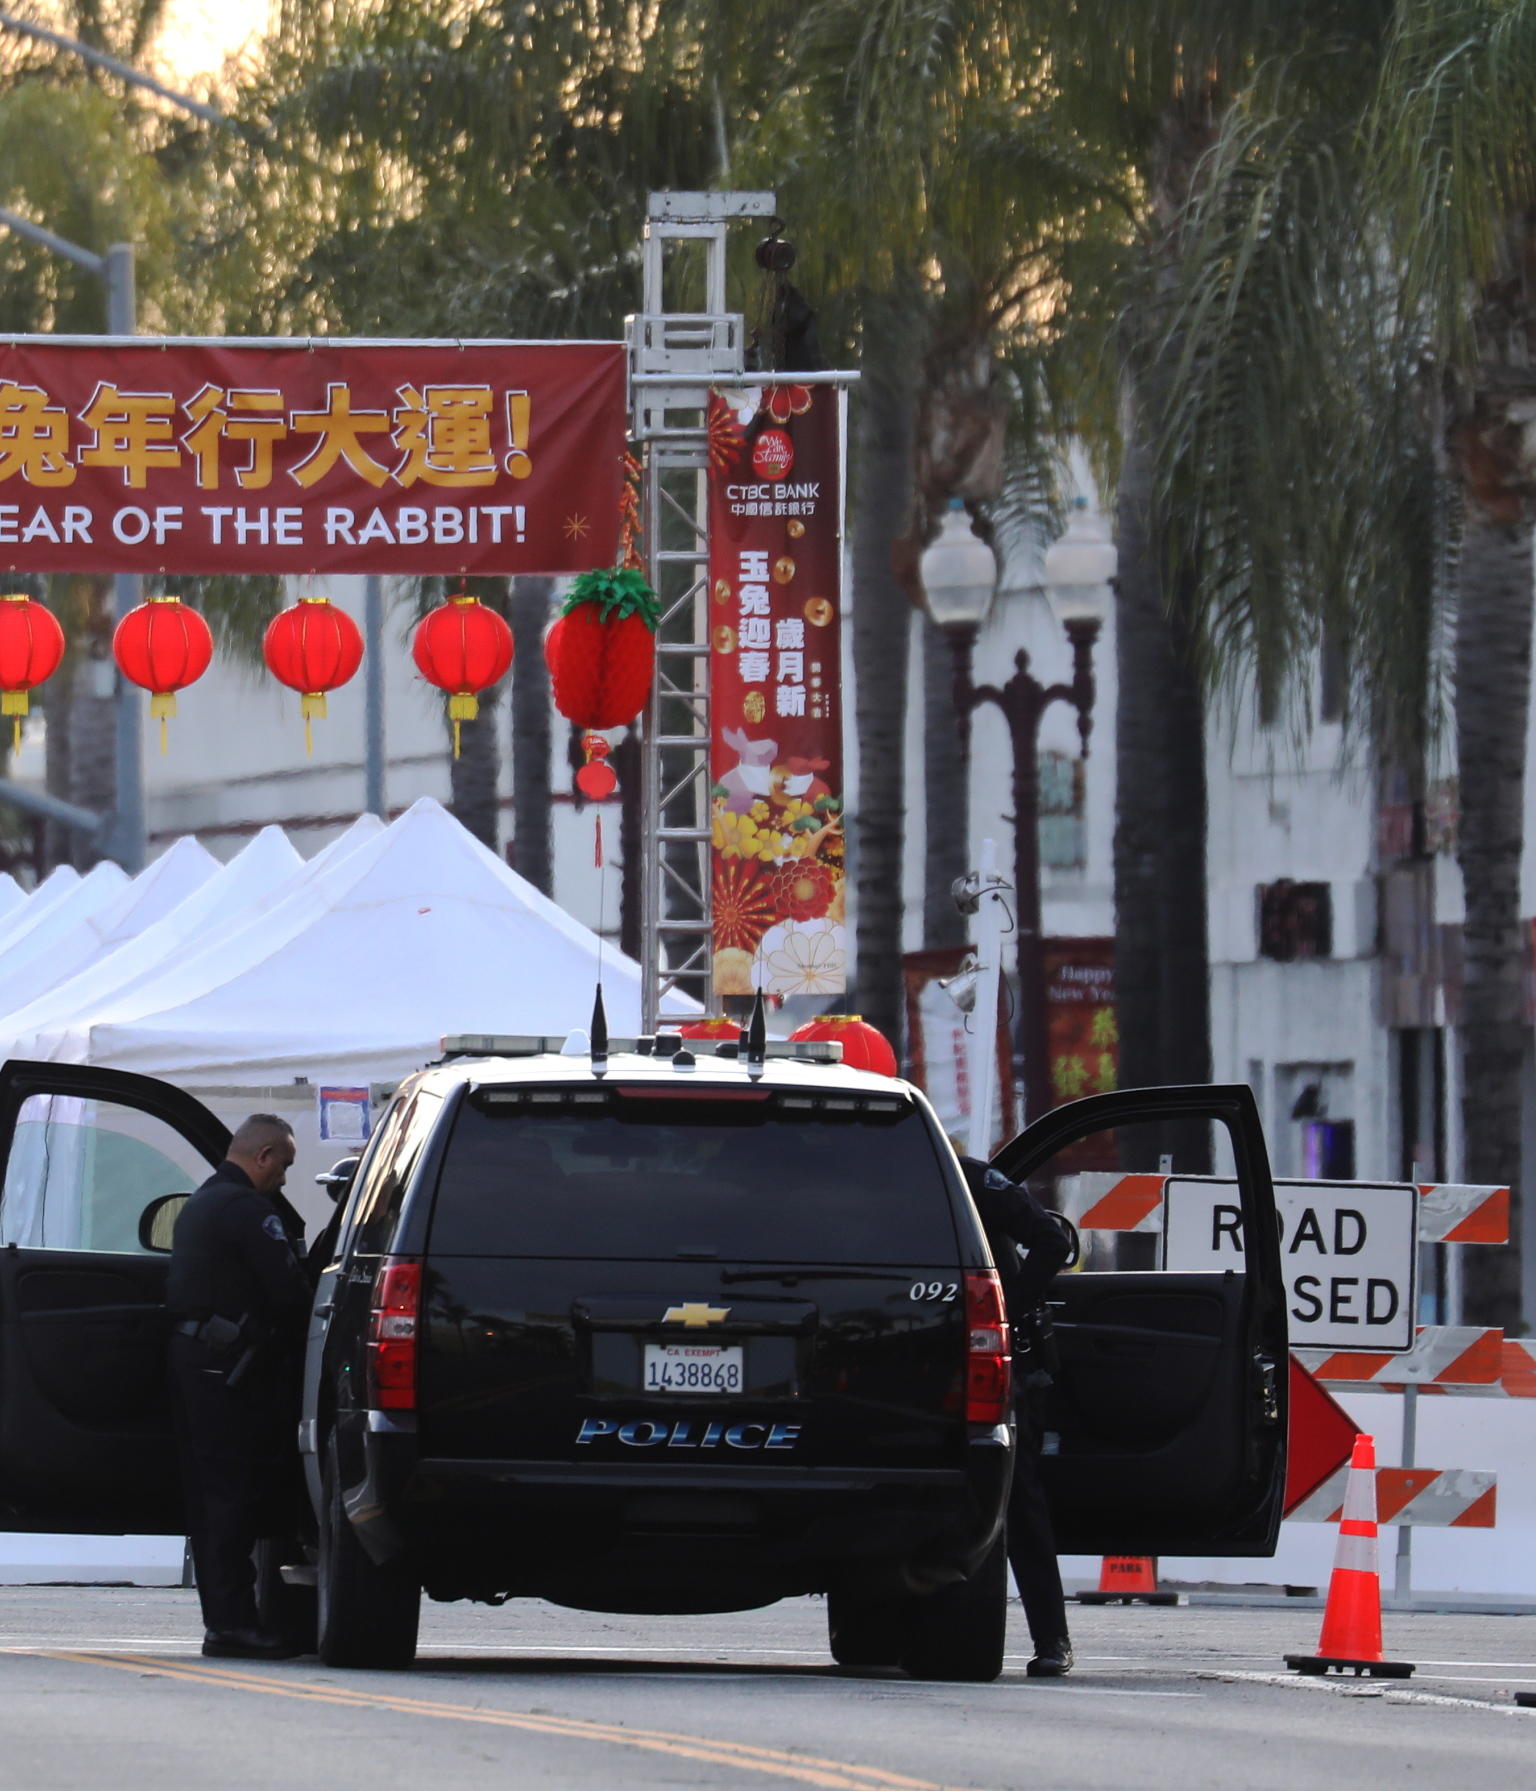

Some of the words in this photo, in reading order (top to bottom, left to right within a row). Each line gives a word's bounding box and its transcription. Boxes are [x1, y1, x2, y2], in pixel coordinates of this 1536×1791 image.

[727, 484, 770, 500] CTBC
[775, 482, 821, 499] BANK
[112, 505, 184, 546] OF
[201, 506, 303, 545] THE
[326, 506, 528, 546] RABBIT!
[738, 550, 771, 683] 玉兔迎春
[776, 618, 806, 718] 歲月新
[1061, 965, 1113, 984] Happy
[1212, 1204, 1367, 1256] RAD
[910, 1281, 958, 1302] 092
[1291, 1275, 1399, 1325] SED
[667, 1348, 680, 1356] CA
[684, 1348, 721, 1357] EXEMPT
[648, 1361, 739, 1388] 1438868
[575, 1418, 802, 1449] POLICE
